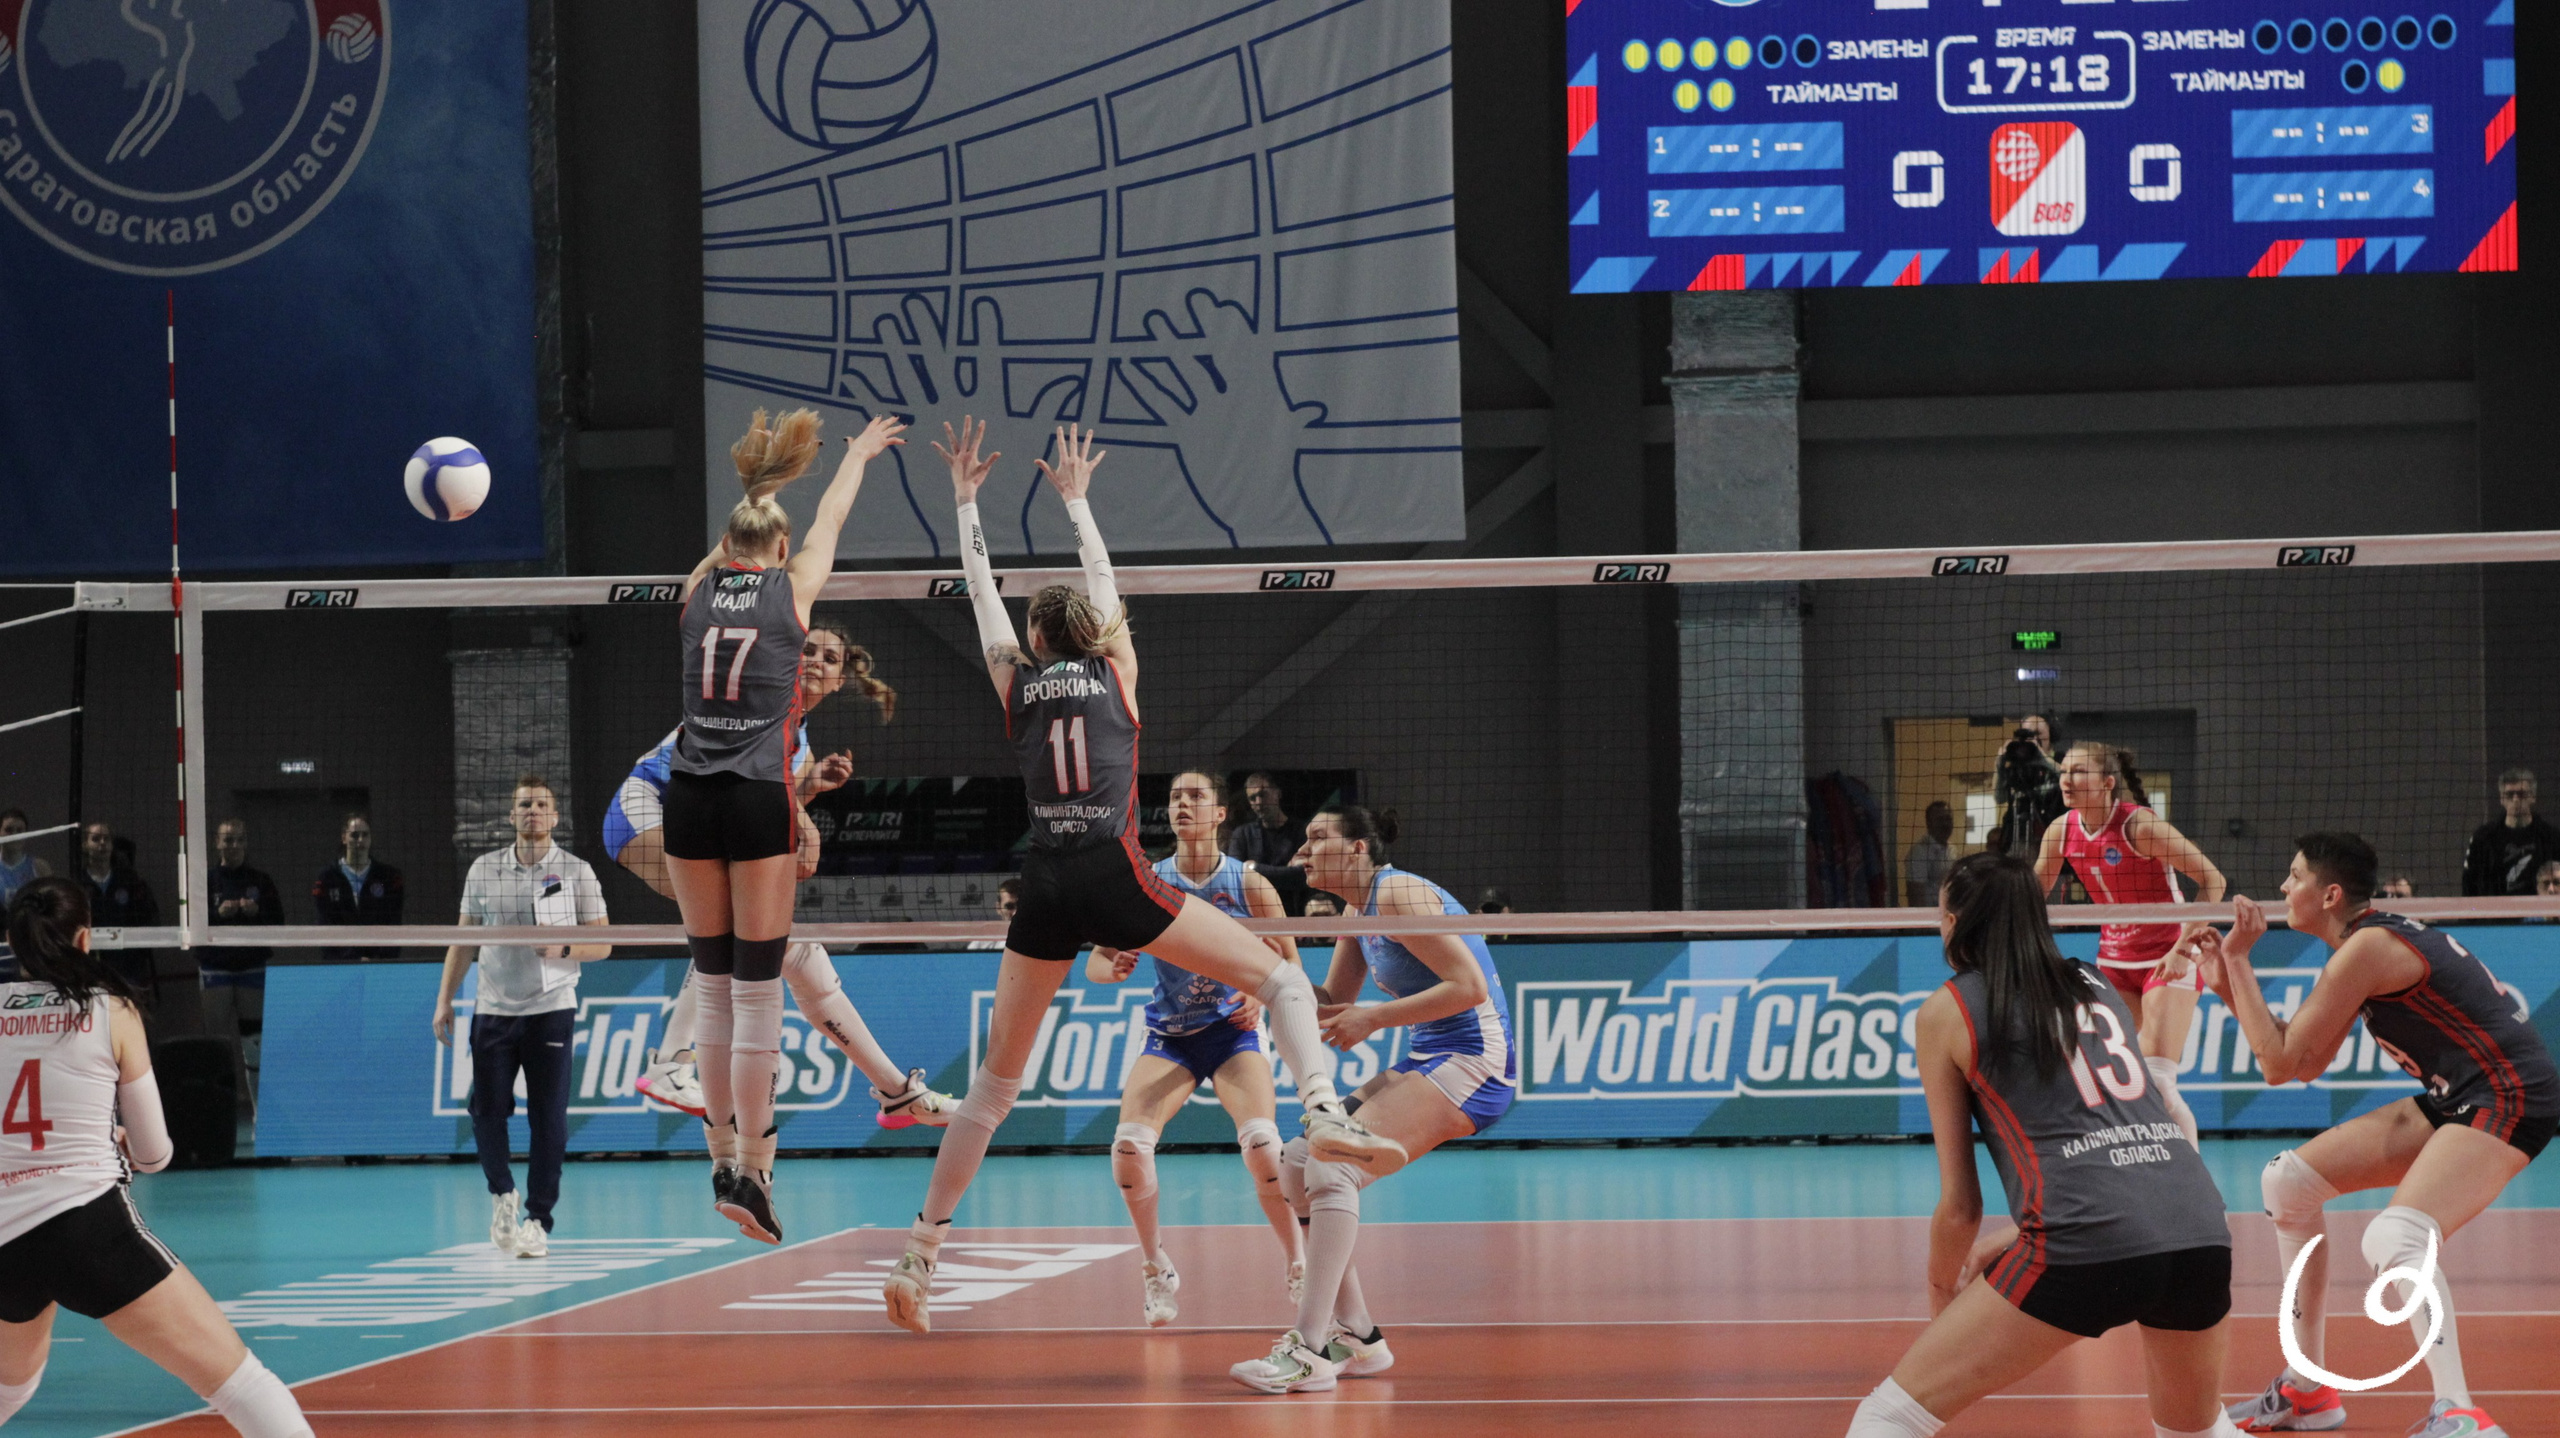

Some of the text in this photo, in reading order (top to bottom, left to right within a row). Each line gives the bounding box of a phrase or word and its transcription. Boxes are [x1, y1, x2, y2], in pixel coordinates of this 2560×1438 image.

[1995, 26, 2077, 48] ВРЕМЯ
[2142, 29, 2246, 50] ЗАМЕНЫ
[1827, 39, 1929, 60] ЗАМЕНЫ
[1967, 54, 2110, 95] 17:18
[2171, 69, 2305, 93] ТАЙМАУТЫ
[1767, 81, 1898, 104] ТАЙМАУТЫ
[2411, 113, 2430, 134] 3
[1654, 137, 1667, 154] 1
[231, 93, 357, 228] область
[1893, 151, 1944, 208] 0
[2129, 144, 2182, 202] 0
[2412, 178, 2430, 197] 4
[1653, 200, 1670, 217] 2
[1937, 557, 2004, 574] PARI
[2283, 547, 2350, 565] PARI
[1264, 572, 1329, 588] PARI
[1599, 565, 1665, 581] PARI
[291, 590, 354, 607] PARI
[613, 584, 679, 601] PARI
[712, 591, 758, 612] КАДИ
[701, 626, 758, 700] 17
[1024, 678, 1108, 704] БРОВКИНА
[1048, 715, 1091, 794] 11
[0, 1012, 93, 1037] ФИМЕНКО
[823, 1018, 850, 1046] MIKASA
[1152, 1038, 1164, 1051] 3
[1533, 996, 1738, 1084] World
[2055, 1002, 2146, 1108] 13
[2, 1058, 54, 1152] 4
[2108, 1143, 2171, 1167] ОБЛАСТЬ
